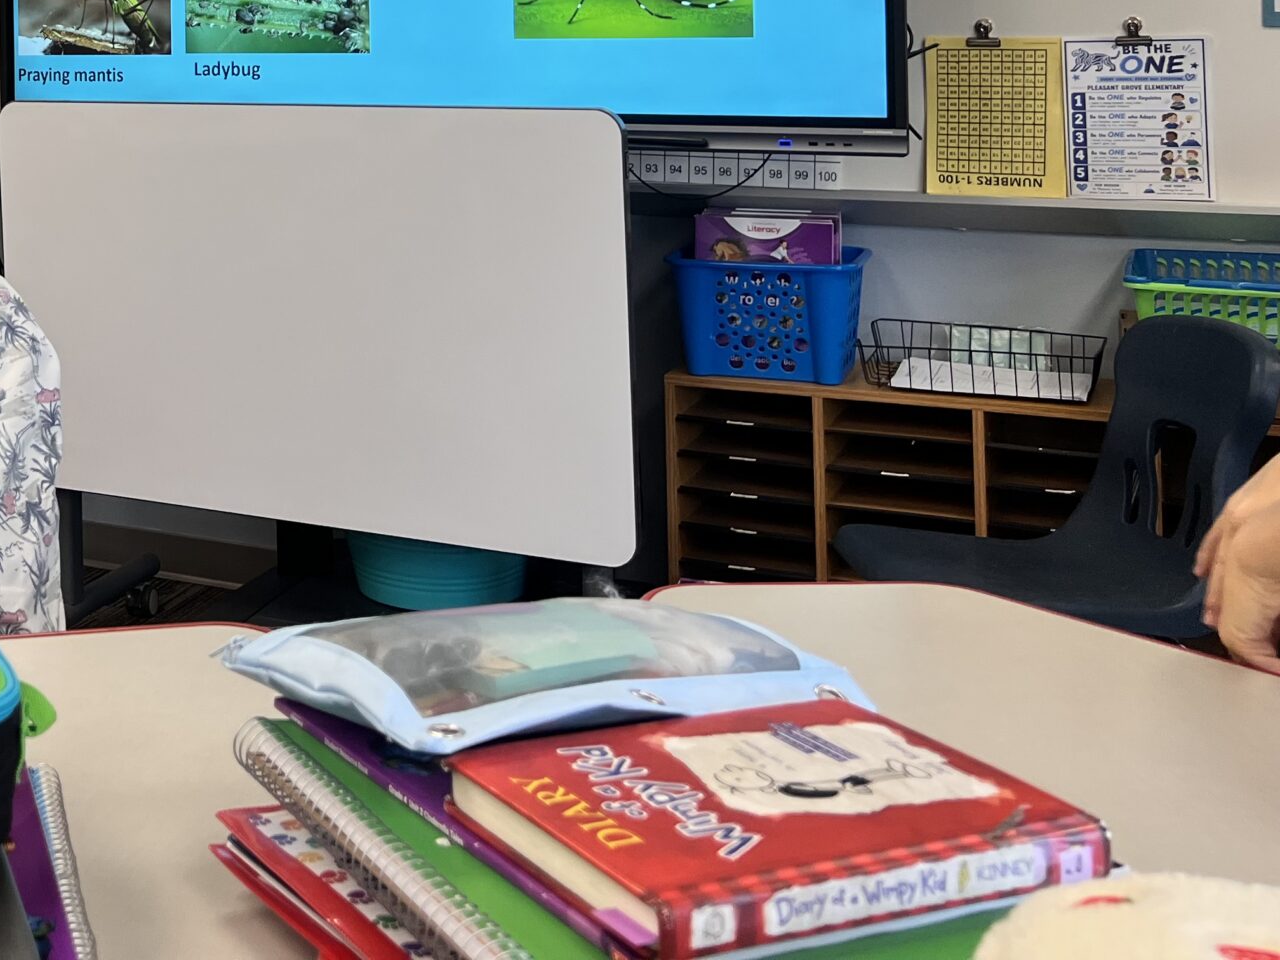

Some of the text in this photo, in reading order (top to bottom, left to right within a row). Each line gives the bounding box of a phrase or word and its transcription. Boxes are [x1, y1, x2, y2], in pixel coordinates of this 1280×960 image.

[1122, 43, 1172, 54] BE THE
[194, 60, 262, 82] Ladybug
[1119, 54, 1186, 75] ONE
[18, 67, 125, 86] Praying mantis
[1074, 94, 1083, 107] 1
[1074, 113, 1083, 124] 2
[1108, 112, 1126, 120] ONE
[1075, 131, 1084, 143] 3
[1108, 130, 1125, 138] ONE
[1075, 149, 1085, 161] 4
[1108, 148, 1125, 156] ONE
[645, 162, 838, 183] 93 94 95 96 97 98 99 100
[1076, 167, 1085, 178] 5
[1108, 166, 1124, 174] ONE
[938, 173, 1043, 188] NUMBERS 1-100
[747, 225, 782, 235] Literacy
[556, 743, 763, 860] Wimpy Kid
[593, 784, 649, 819] of a
[508, 775, 646, 851] DIARY
[975, 857, 1034, 881] KINNEY
[775, 891, 827, 927] Diary
[831, 888, 845, 906] of
[861, 879, 918, 909] Wimpy
[920, 867, 948, 896] Kid
